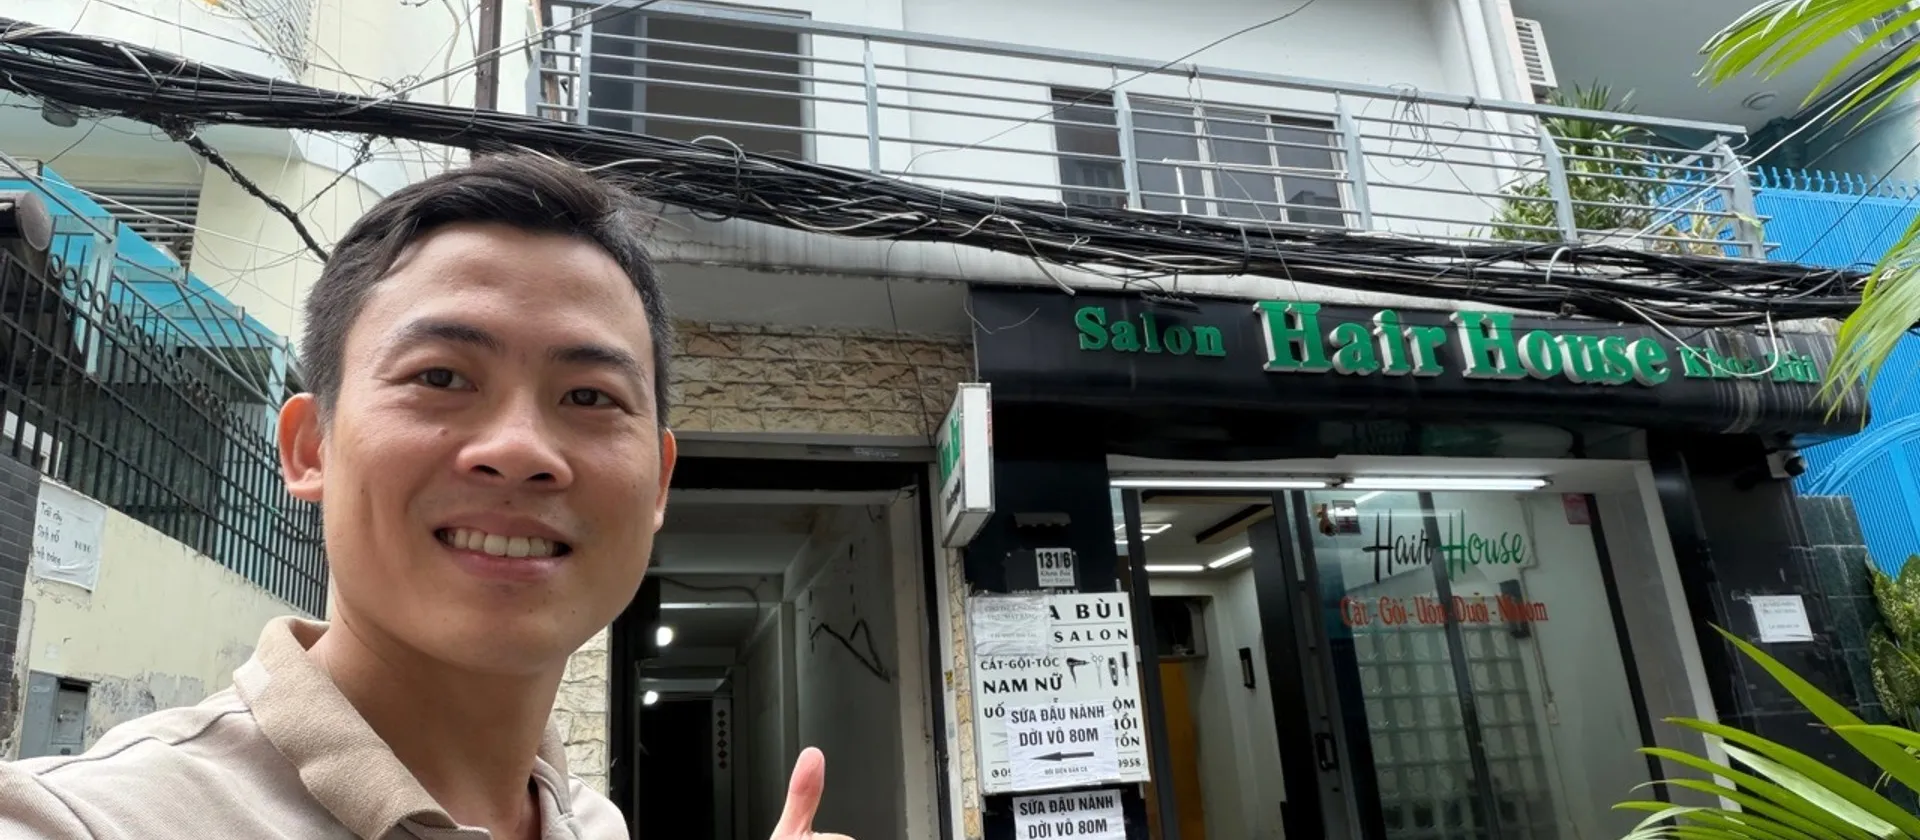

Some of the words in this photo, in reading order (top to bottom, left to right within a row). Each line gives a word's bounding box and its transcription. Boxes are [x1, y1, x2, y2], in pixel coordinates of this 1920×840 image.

[1075, 306, 1227, 356] Salon
[1253, 301, 1447, 376] Hair
[1449, 311, 1671, 386] House
[1362, 508, 1433, 584] Hair
[1439, 509, 1525, 582] House
[1075, 598, 1125, 619] BÙI
[1054, 629, 1128, 643] SALON
[983, 678, 1028, 694] NAM
[1035, 672, 1063, 691] NỮ
[984, 701, 1005, 718] UỐ
[1112, 696, 1135, 713] ỘM
[1041, 705, 1066, 724] ĐẬU
[1019, 728, 1043, 747] DỜI
[1046, 726, 1065, 745] VÔ
[1069, 727, 1099, 743] 80M
[1049, 797, 1075, 815] ĐẬU
[1028, 820, 1051, 839] DỜI
[1056, 818, 1074, 836] VÔ
[1078, 818, 1108, 835] 80M
